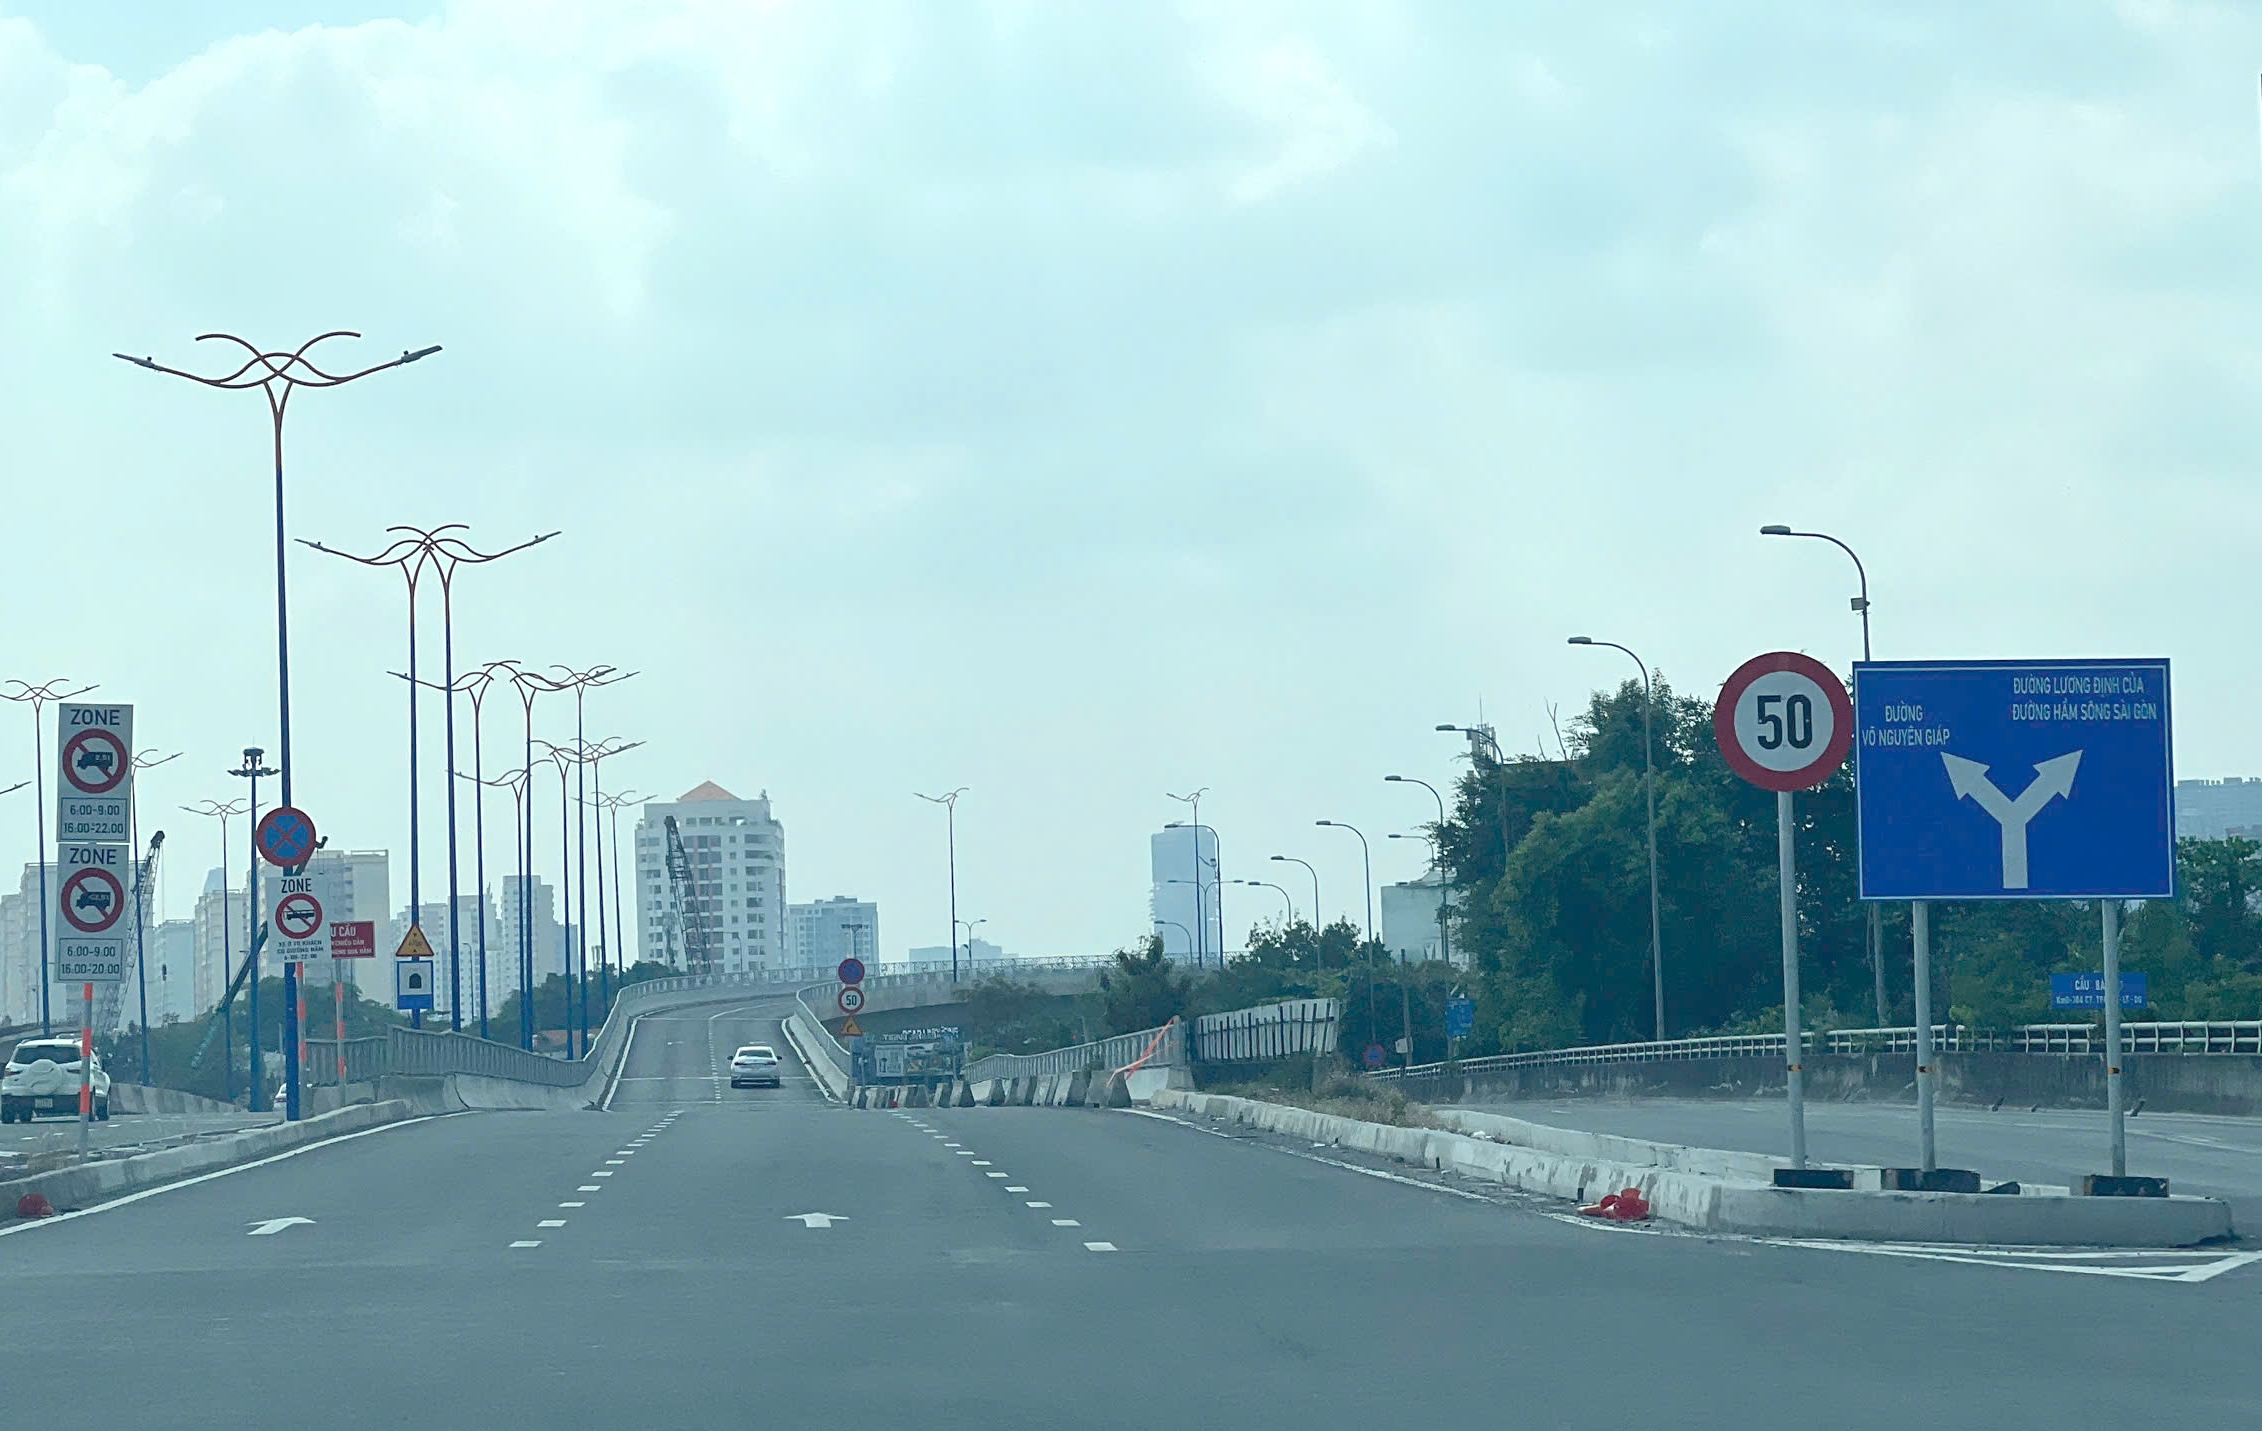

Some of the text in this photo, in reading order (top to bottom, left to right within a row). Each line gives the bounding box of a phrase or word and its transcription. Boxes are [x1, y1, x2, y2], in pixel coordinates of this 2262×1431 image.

[2013, 674, 2050, 694] ĐƯỜNG
[2053, 676, 2090, 694] LƯƠNG
[2093, 676, 2120, 697] ĐỊNH
[70, 709, 120, 725] ZONE
[1885, 700, 1923, 722] ĐƯỜNG
[2012, 700, 2050, 720] ĐƯỜNG
[2080, 700, 2111, 720] SÔNG
[2113, 700, 2130, 719] SÀI
[2133, 700, 2157, 719] GÒN
[1757, 694, 1813, 750] 50
[1879, 725, 1922, 746] NGUYÊN
[1925, 724, 1950, 745] GIÁP
[69, 848, 117, 864] ZONE
[281, 878, 312, 893] ZONE
[845, 995, 857, 1006] 50
